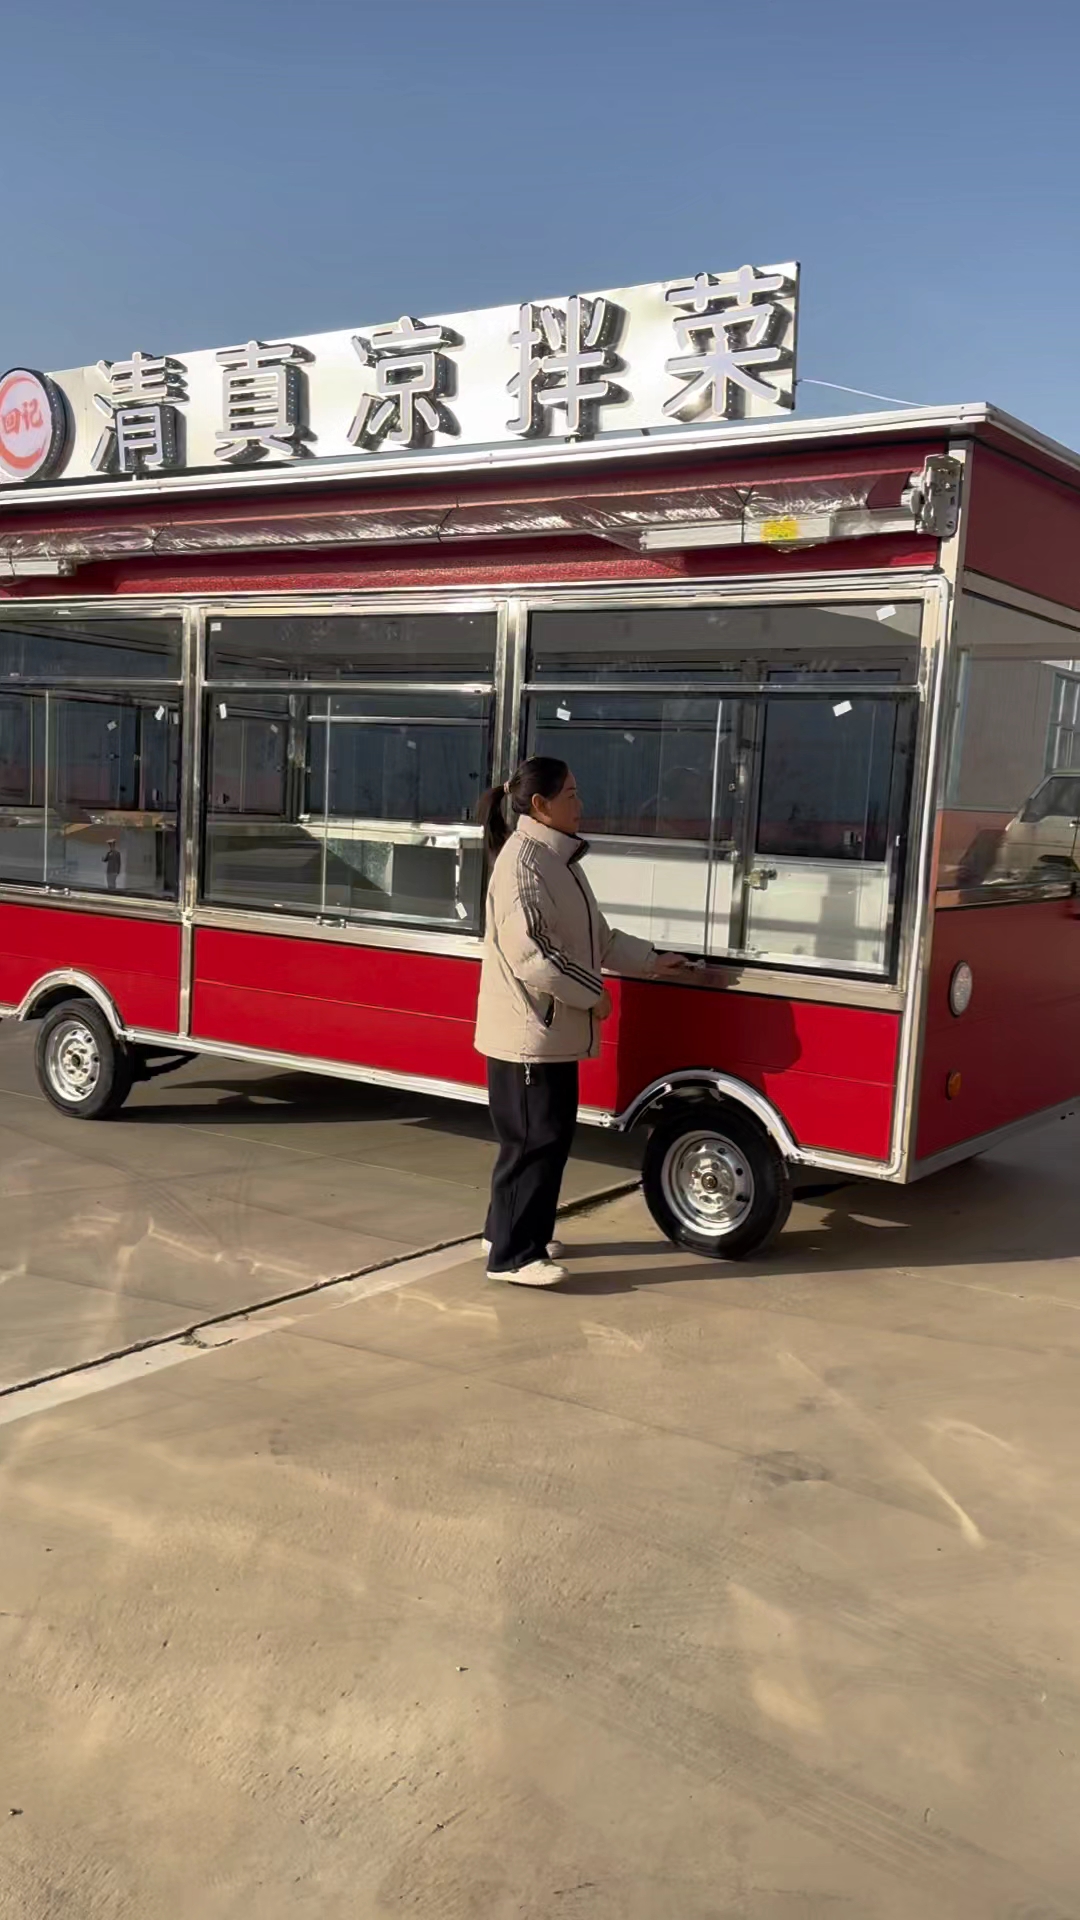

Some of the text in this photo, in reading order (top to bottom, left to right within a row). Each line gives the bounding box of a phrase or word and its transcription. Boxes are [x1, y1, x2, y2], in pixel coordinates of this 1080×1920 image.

[90, 265, 788, 473] 清真凉拌菜
